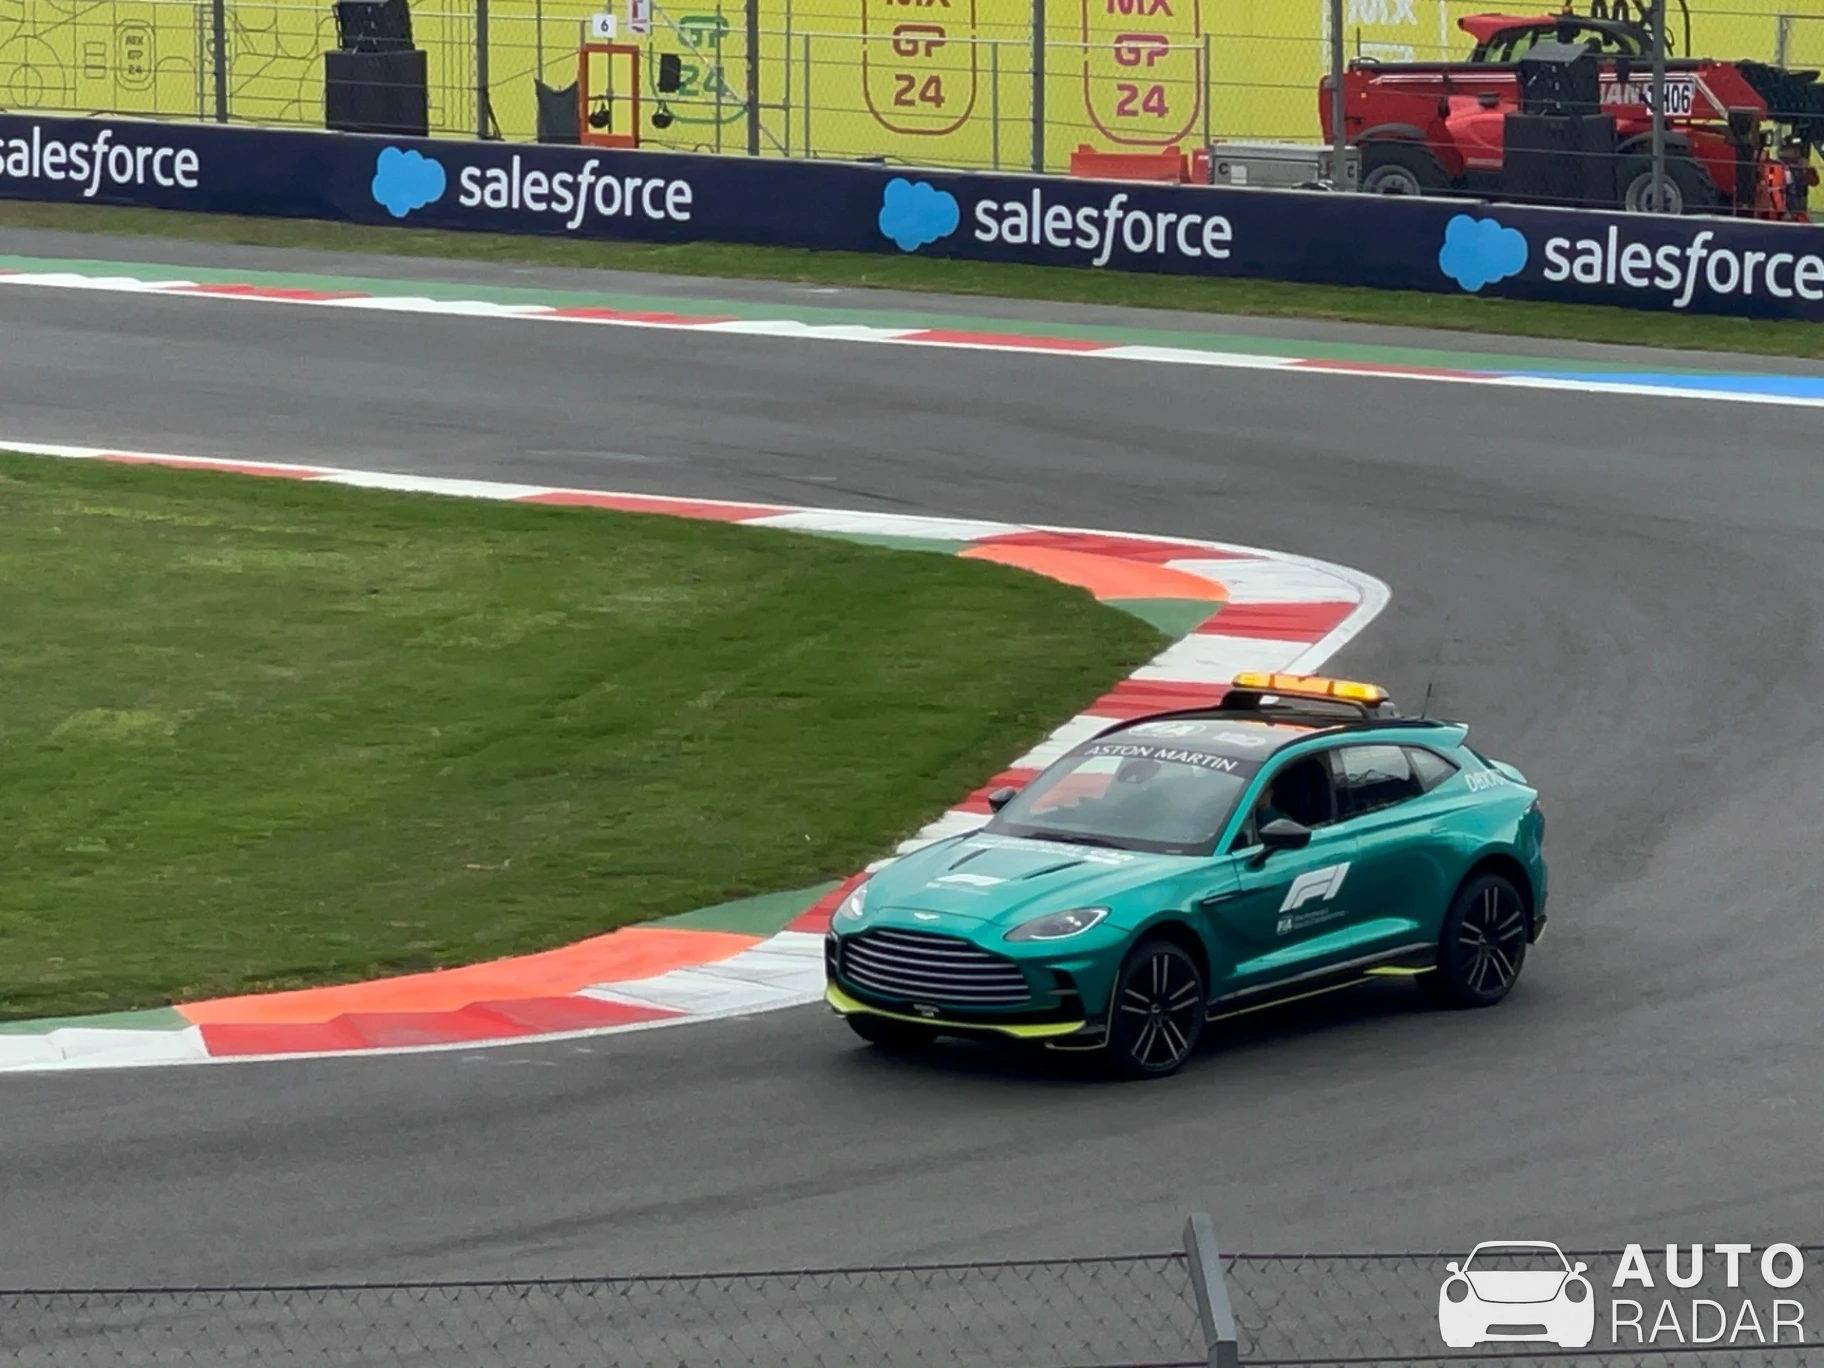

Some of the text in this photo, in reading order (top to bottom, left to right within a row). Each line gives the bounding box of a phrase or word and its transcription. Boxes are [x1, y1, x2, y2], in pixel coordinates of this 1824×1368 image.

[600, 20, 609, 32] 6
[678, 15, 729, 48] GP
[892, 24, 945, 57] GP
[1114, 34, 1169, 67] GP
[678, 64, 727, 96] 24
[893, 73, 945, 108] 24
[1116, 83, 1169, 118] 24
[0, 126, 199, 197] alesforce
[459, 154, 693, 229] salesforce
[974, 188, 1233, 266] salesforce
[1543, 225, 1824, 308] salesforce
[1084, 744, 1238, 772] ASTON MARTIN
